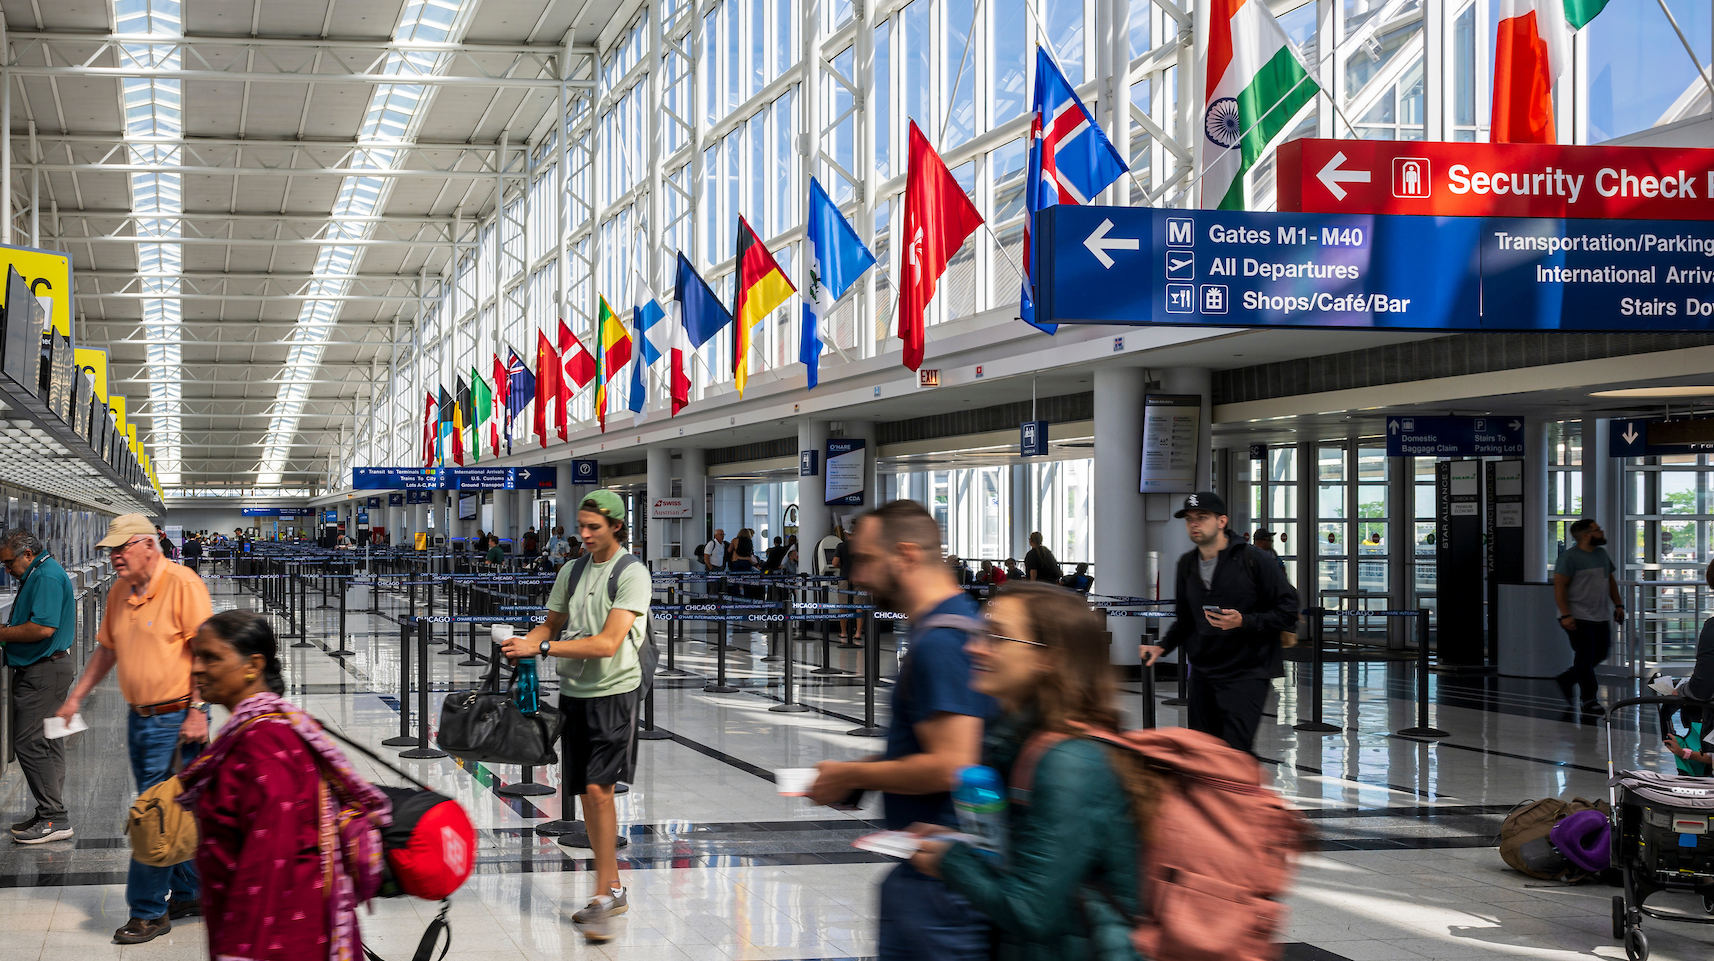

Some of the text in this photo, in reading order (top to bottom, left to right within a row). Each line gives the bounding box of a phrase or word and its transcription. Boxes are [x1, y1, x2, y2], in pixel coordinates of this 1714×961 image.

[1448, 164, 1584, 203] Security
[1595, 167, 1697, 199] Check
[1170, 222, 1191, 243] M
[1208, 224, 1271, 244] Gates
[1494, 231, 1714, 257] Transportation/Parking
[1209, 257, 1359, 281] All Departures
[1536, 264, 1714, 284] International Arriv
[1242, 291, 1411, 314] Shops/Café/Bar
[1620, 297, 1714, 316] Stairs Do
[920, 369, 938, 383] EXIT
[1476, 421, 1483, 430] P
[1401, 444, 1458, 454] Baggage Claim
[1474, 445, 1502, 454] Parking
